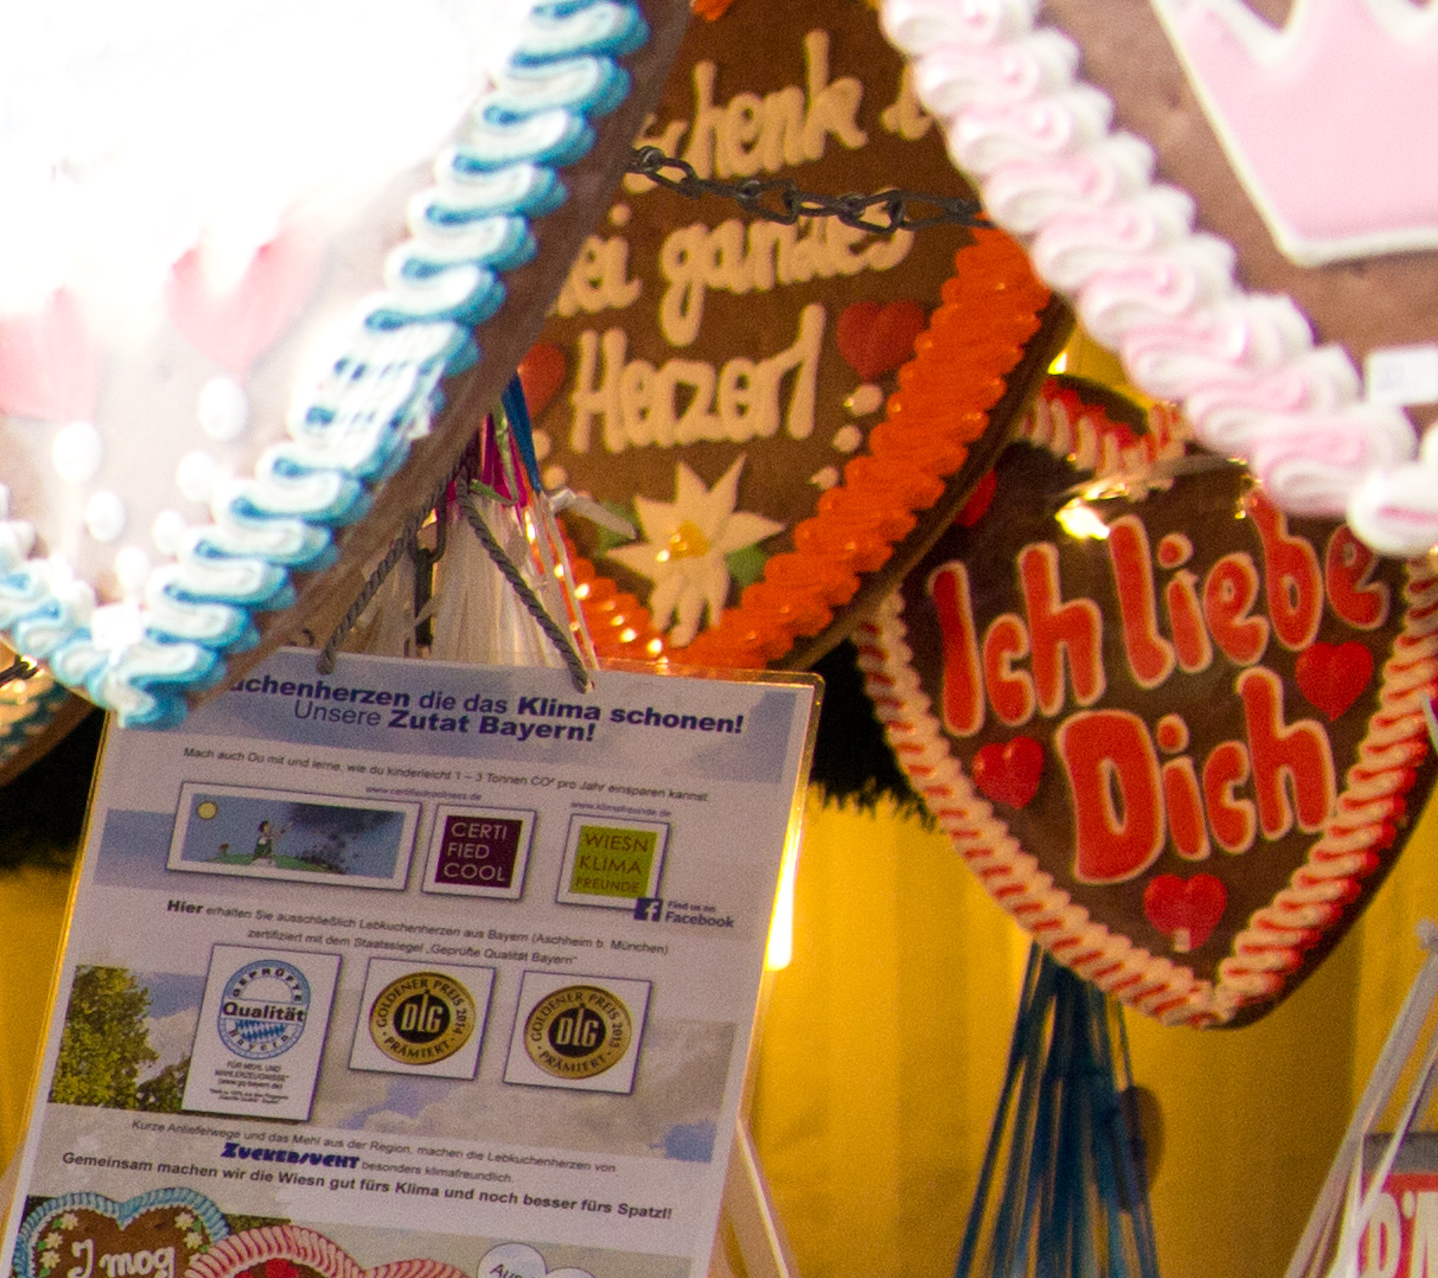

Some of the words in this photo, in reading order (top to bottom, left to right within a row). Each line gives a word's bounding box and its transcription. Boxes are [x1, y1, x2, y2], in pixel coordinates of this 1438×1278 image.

[570, 302, 827, 453] Herzerl
[926, 543, 1105, 739] Ich
[1106, 484, 1390, 688] liebe
[295, 700, 381, 727] Unsere
[387, 709, 470, 733] Zutat
[479, 715, 596, 742] Bayern!
[419, 691, 456, 711] die
[463, 694, 507, 713] das
[518, 697, 601, 721] Klima
[610, 708, 744, 734] schonen!
[183, 746, 215, 759] Mach
[217, 749, 245, 761] auch
[248, 751, 264, 763] Du
[267, 754, 285, 765] mit
[288, 756, 310, 767] und
[347, 763, 367, 774] wie
[369, 764, 384, 776] du
[487, 773, 528, 786] Tonnen
[557, 779, 577, 790] pro
[1055, 666, 1335, 885] Dich
[451, 821, 507, 840] CERTI
[585, 833, 649, 853] WIESN
[447, 842, 490, 860] FIED
[579, 856, 642, 876] KLIMA
[443, 863, 507, 882] COOL
[575, 877, 641, 894] FREUNDE
[167, 900, 204, 914] Hier
[206, 906, 252, 919] erhalten
[255, 909, 274, 921] Sie
[359, 919, 461, 938] Lebkuchenherzen
[464, 929, 484, 940] aus
[488, 929, 528, 944] Bayern
[665, 911, 734, 928] Facebook
[248, 928, 302, 944] zertifiziert
[305, 932, 322, 944] mit
[325, 935, 350, 947] dem
[223, 1001, 307, 1022] Qualität
[376, 978, 430, 1029] GOLDENER
[432, 979, 464, 1014] PREIS
[530, 992, 585, 1043] GOLDENER
[588, 993, 620, 1024] PREIS
[384, 1034, 451, 1061] PRÄMIERT
[539, 1049, 607, 1073] PRÄMIERT
[132, 1120, 166, 1133] Kurze
[244, 1129, 263, 1141] und
[268, 1132, 289, 1144] das
[292, 1134, 321, 1147] Mehl
[323, 1138, 344, 1149] aus
[347, 1138, 367, 1150] der
[417, 1146, 464, 1159] machen
[466, 1149, 484, 1161] die
[487, 1152, 591, 1171] Lebkuchenherzen
[594, 1164, 616, 1173] von
[219, 1141, 361, 1169] ZUCKERSUCHT
[362, 1161, 422, 1175] besonders
[62, 1152, 153, 1172] Gemeinsam
[157, 1162, 218, 1178] machen
[222, 1167, 247, 1180] wir
[250, 1169, 273, 1183] die
[279, 1172, 325, 1188] Wiesn
[329, 1177, 356, 1191] gut
[360, 1179, 390, 1193] fürs
[395, 1181, 440, 1198] Klima
[444, 1188, 474, 1201] und
[478, 1190, 518, 1205] noch
[522, 1193, 577, 1211] besser
[581, 1199, 612, 1214] fürs
[617, 1202, 672, 1220] Spatzl!
